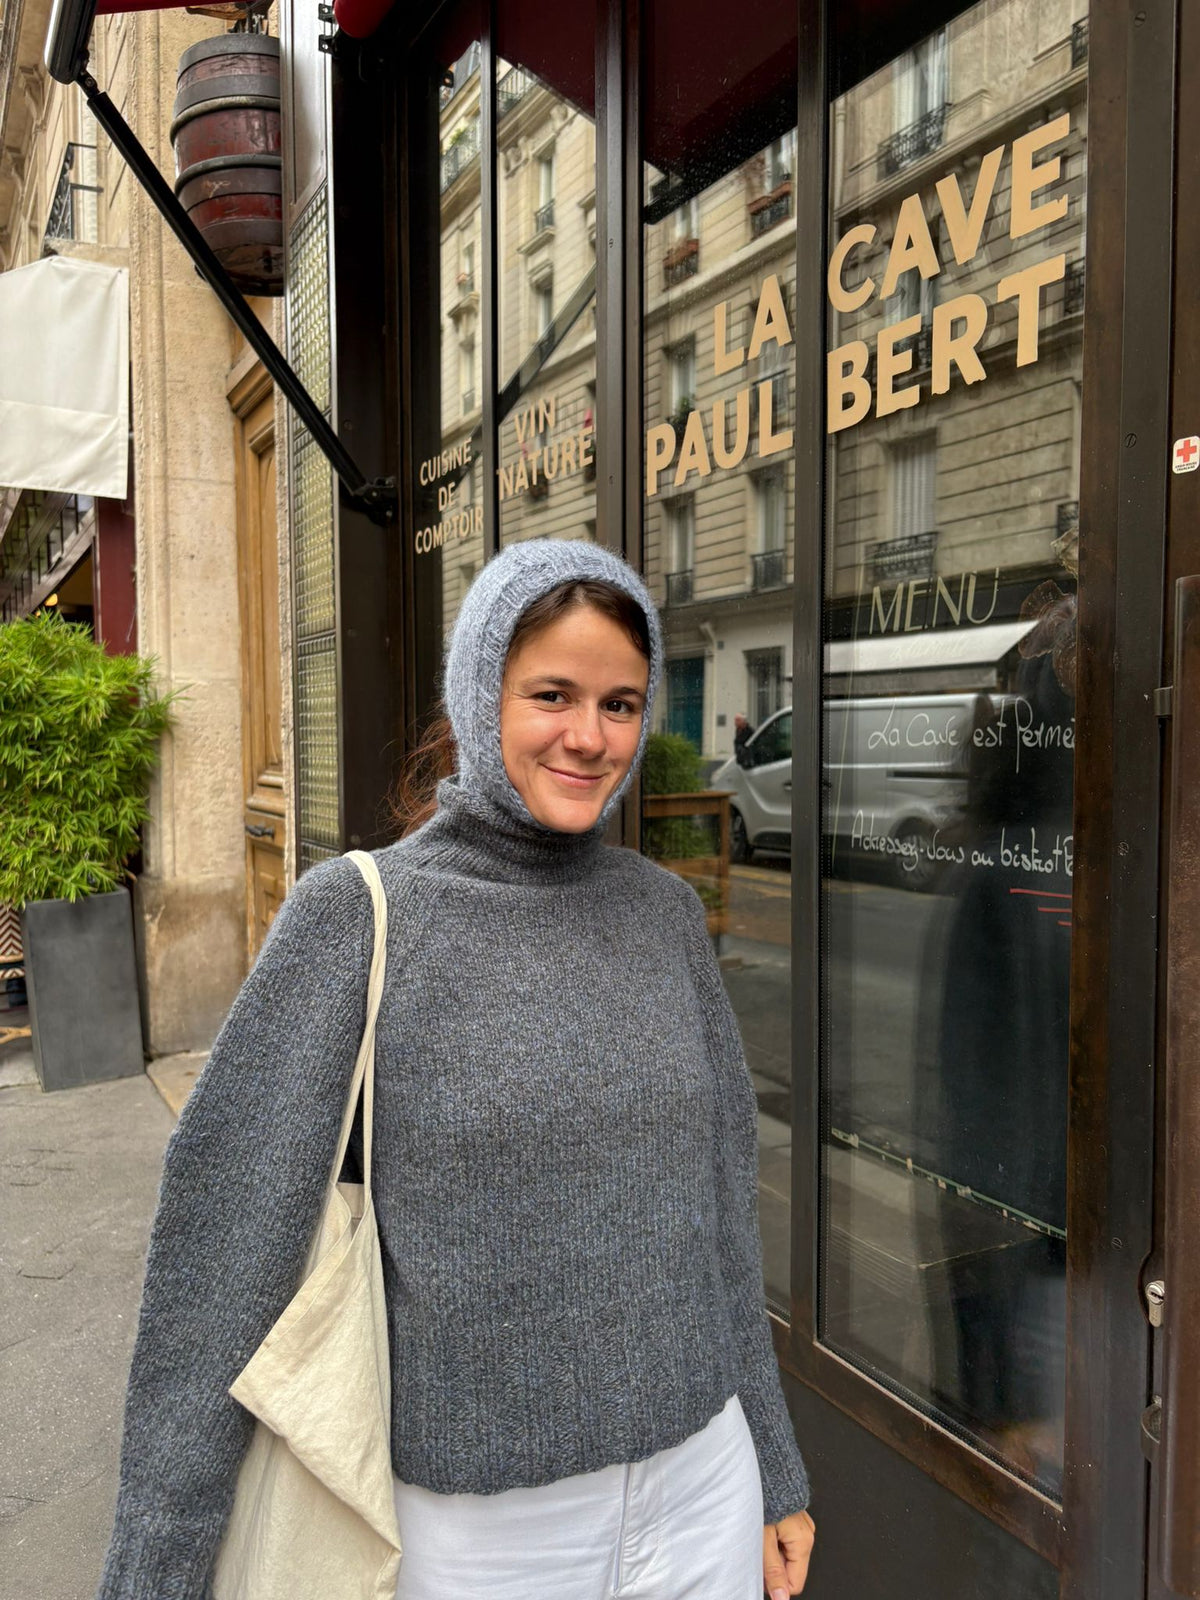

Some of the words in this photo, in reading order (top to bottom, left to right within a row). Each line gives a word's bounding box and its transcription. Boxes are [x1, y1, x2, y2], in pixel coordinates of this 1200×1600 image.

[713, 273, 793, 377] LA
[827, 112, 1070, 313] CAVE
[646, 380, 794, 497] PAUL
[827, 253, 1066, 434] BERT
[514, 397, 556, 446] VIN
[419, 437, 472, 487] CUISINE
[496, 426, 593, 501] NATURE
[438, 482, 456, 512] DE
[415, 506, 484, 555] COMPTOIR
[869, 567, 1000, 635] MENU
[868, 698, 900, 750] La
[905, 713, 960, 748] Cave
[972, 699, 1007, 748] est
[971, 850, 995, 867] au
[1000, 827, 1063, 873] bistrot
